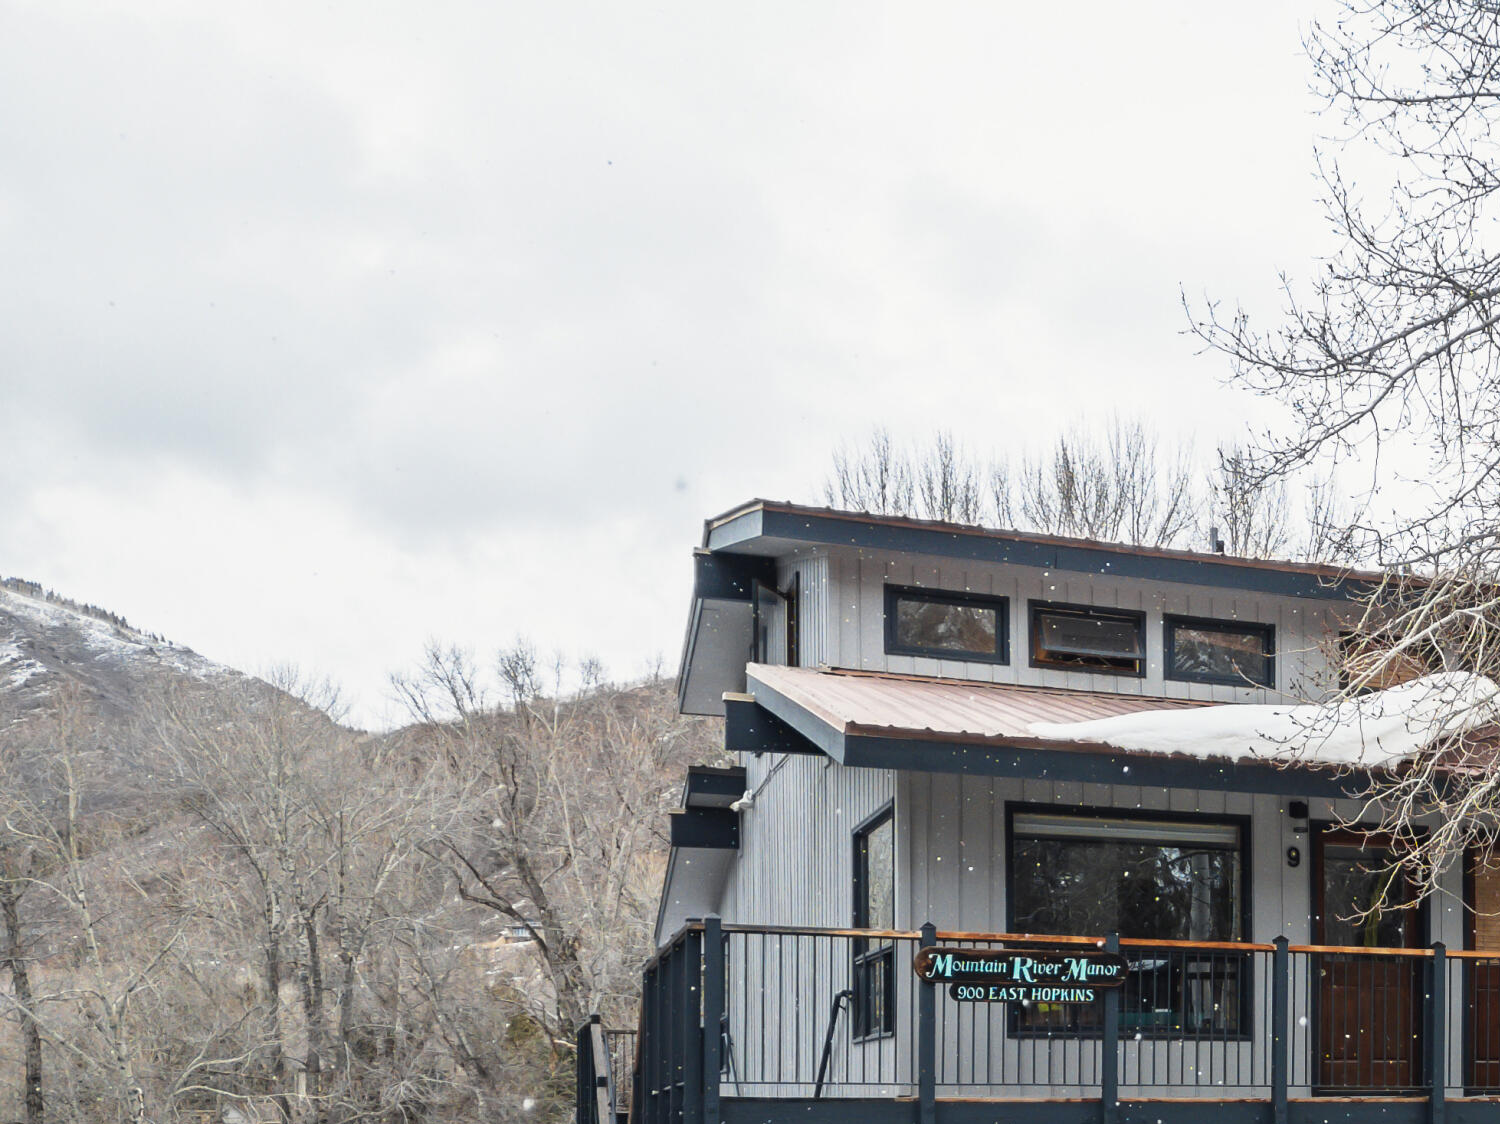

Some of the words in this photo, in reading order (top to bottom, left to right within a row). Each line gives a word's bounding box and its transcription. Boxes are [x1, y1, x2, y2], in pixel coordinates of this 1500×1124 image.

[1286, 846, 1301, 868] 9
[925, 953, 1007, 978] Mountain
[1009, 956, 1062, 983] River
[1060, 958, 1121, 982] Manor
[957, 986, 985, 1000] 900
[988, 986, 1027, 1001] EAST
[1031, 987, 1095, 1002] HOPKINS
